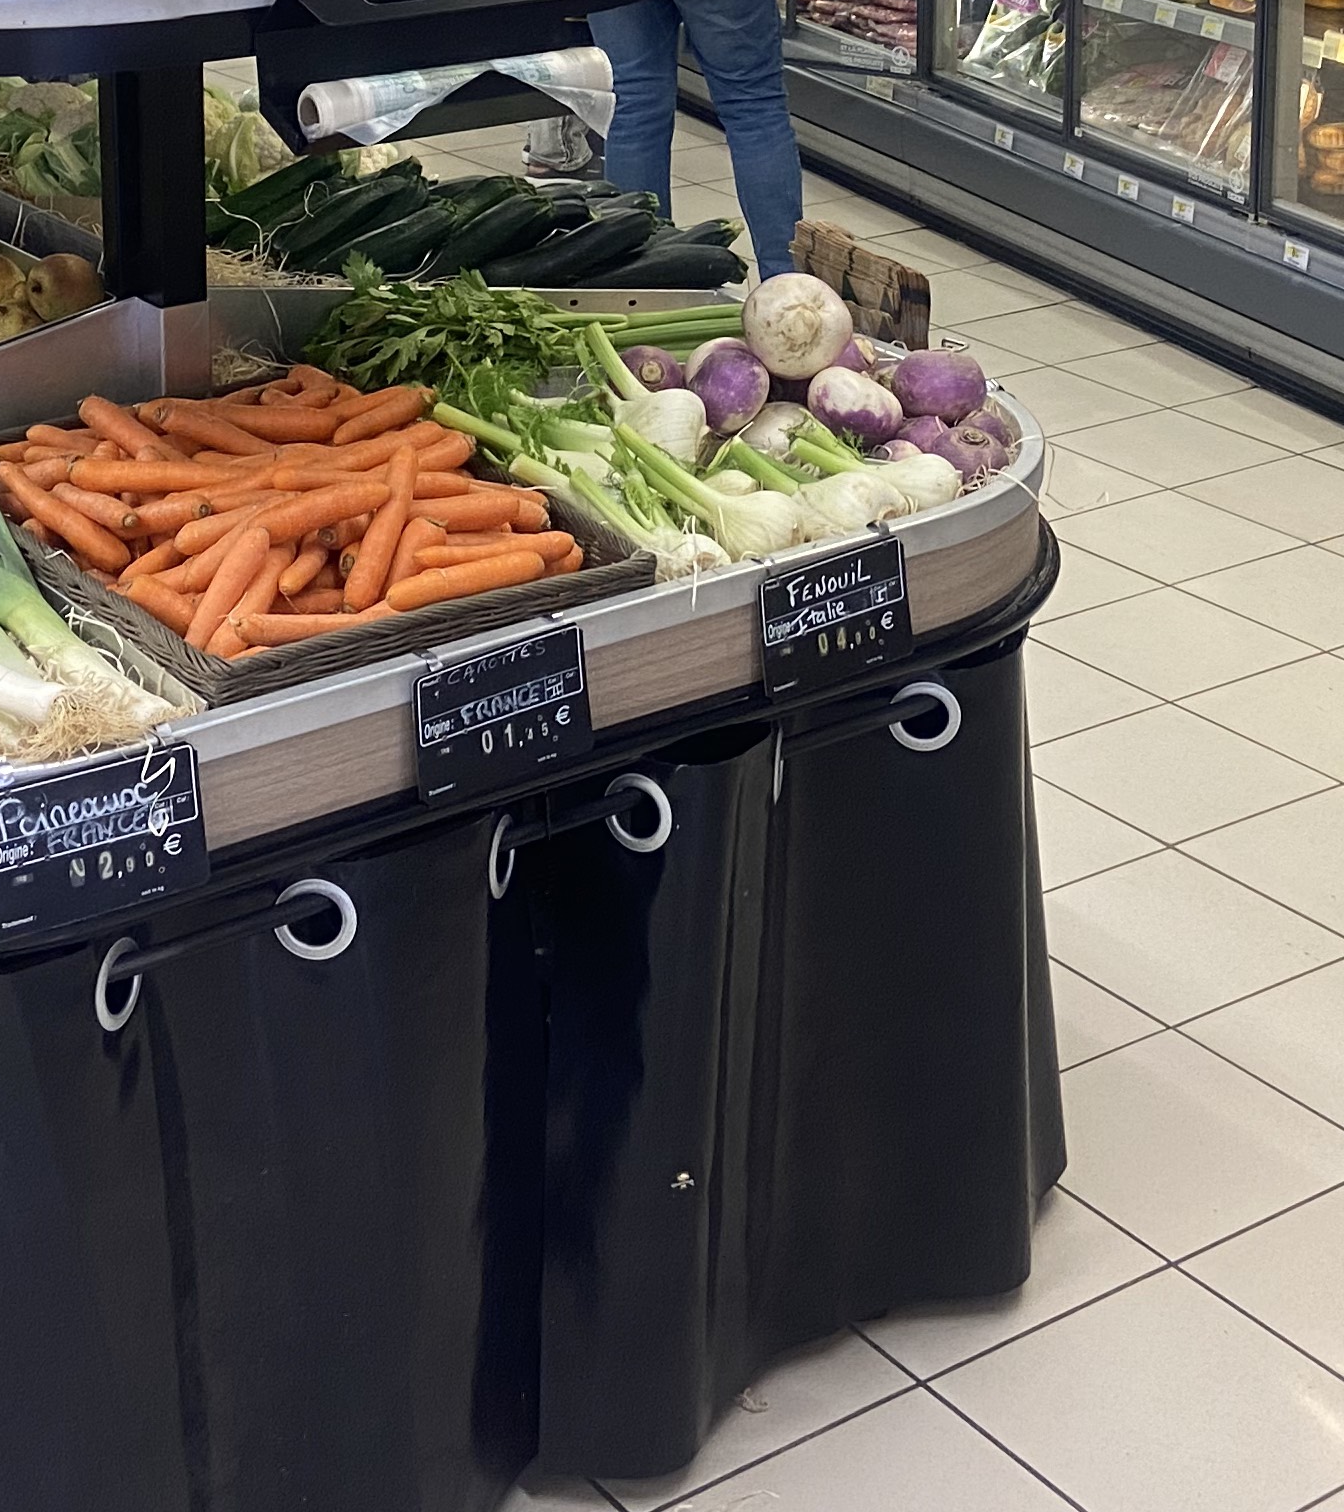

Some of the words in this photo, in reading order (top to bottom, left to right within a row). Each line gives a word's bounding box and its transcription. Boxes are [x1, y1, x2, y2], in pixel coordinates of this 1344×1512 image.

[792, 600, 849, 636] Italie
[447, 640, 546, 686] CAROTTES
[460, 681, 541, 726] FRANCE
[46, 806, 148, 854] FRANCE
